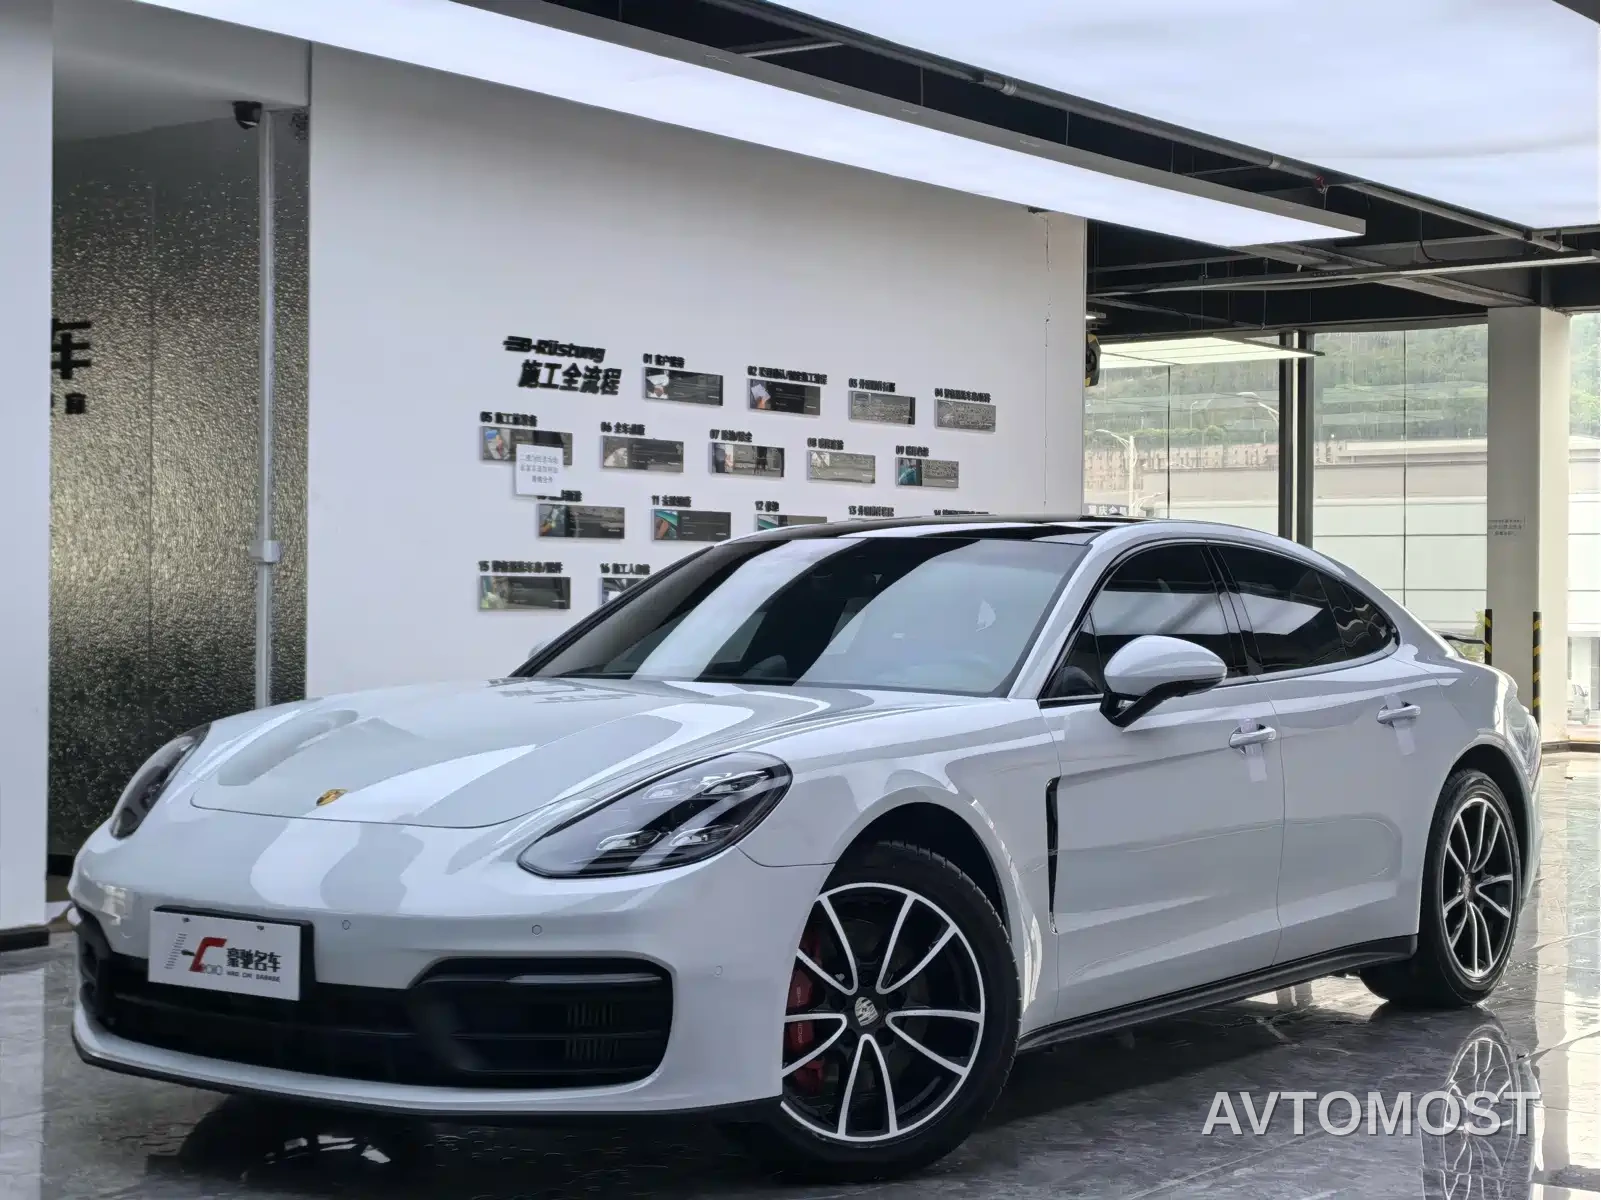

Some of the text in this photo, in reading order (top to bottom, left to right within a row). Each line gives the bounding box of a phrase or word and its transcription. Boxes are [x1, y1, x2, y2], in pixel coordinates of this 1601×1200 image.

[518, 359, 622, 395] 施工全流程
